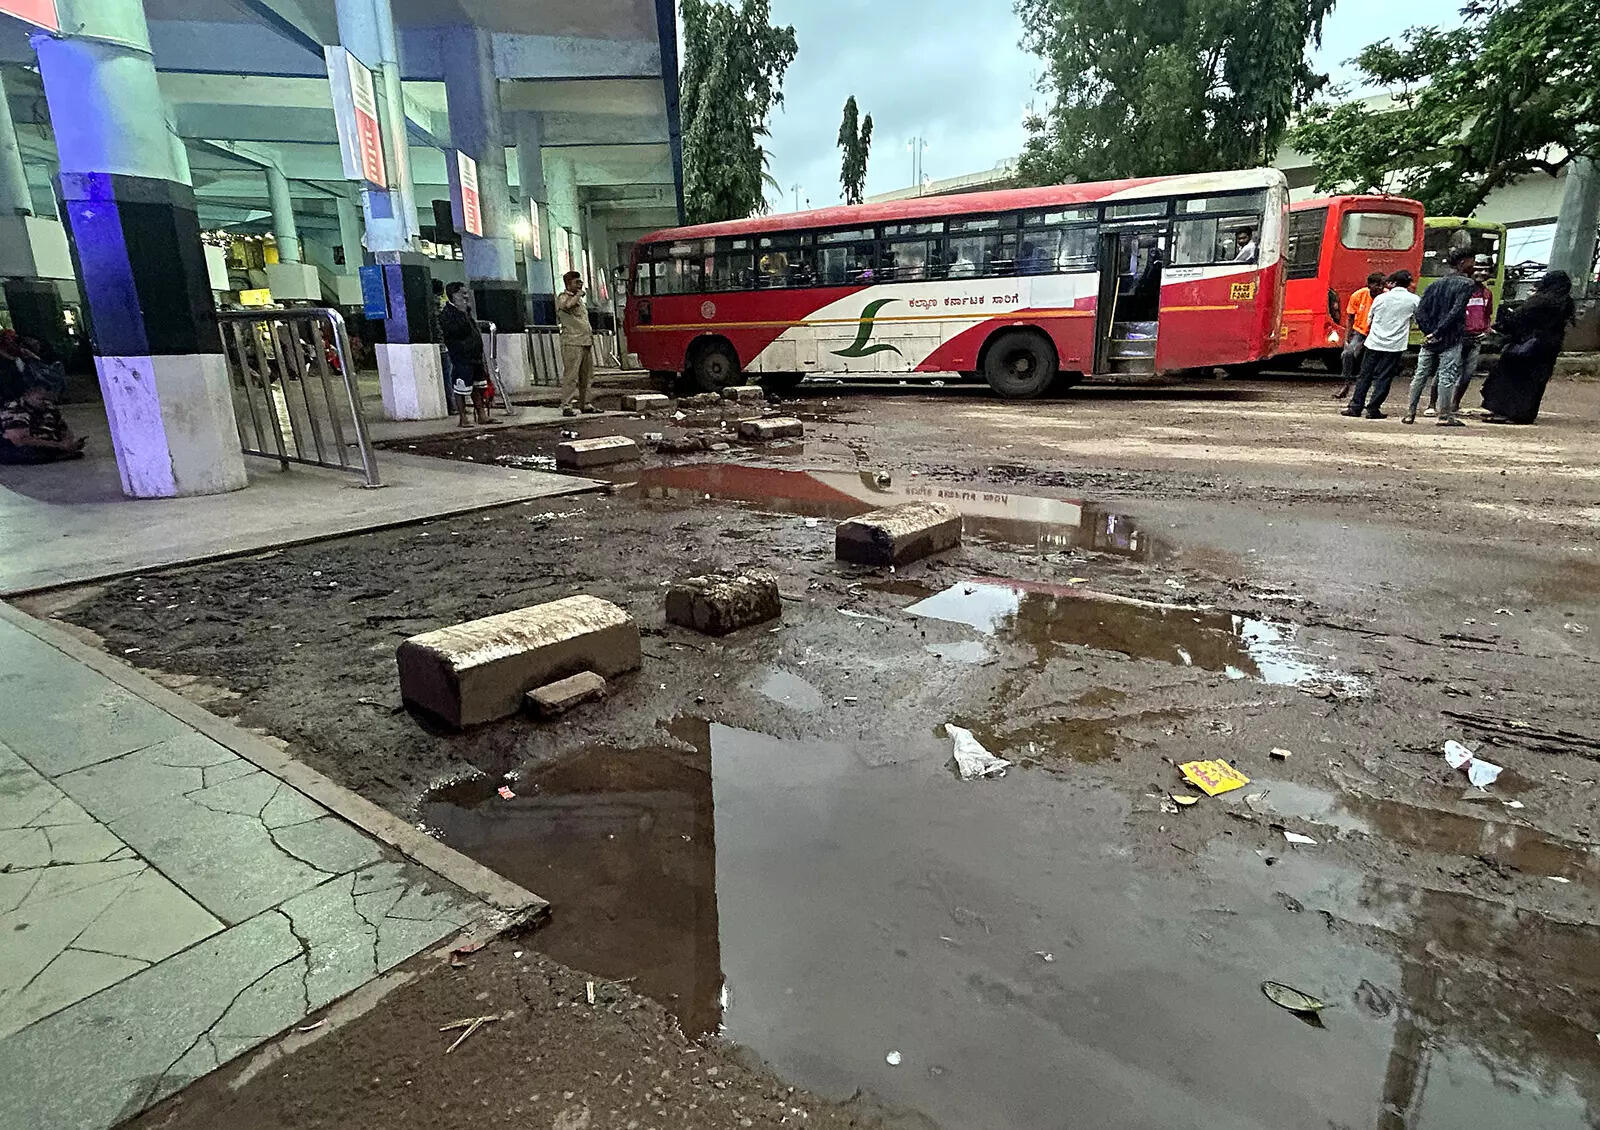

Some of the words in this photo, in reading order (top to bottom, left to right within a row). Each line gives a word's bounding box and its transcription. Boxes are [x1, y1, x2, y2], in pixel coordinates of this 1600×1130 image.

[909, 298, 938, 310] ಕಲ್ಯಾಣ
[944, 295, 985, 306] ಕರ್ನಾಟಕ
[992, 293, 1019, 304] ಸಾರಿಗೆ
